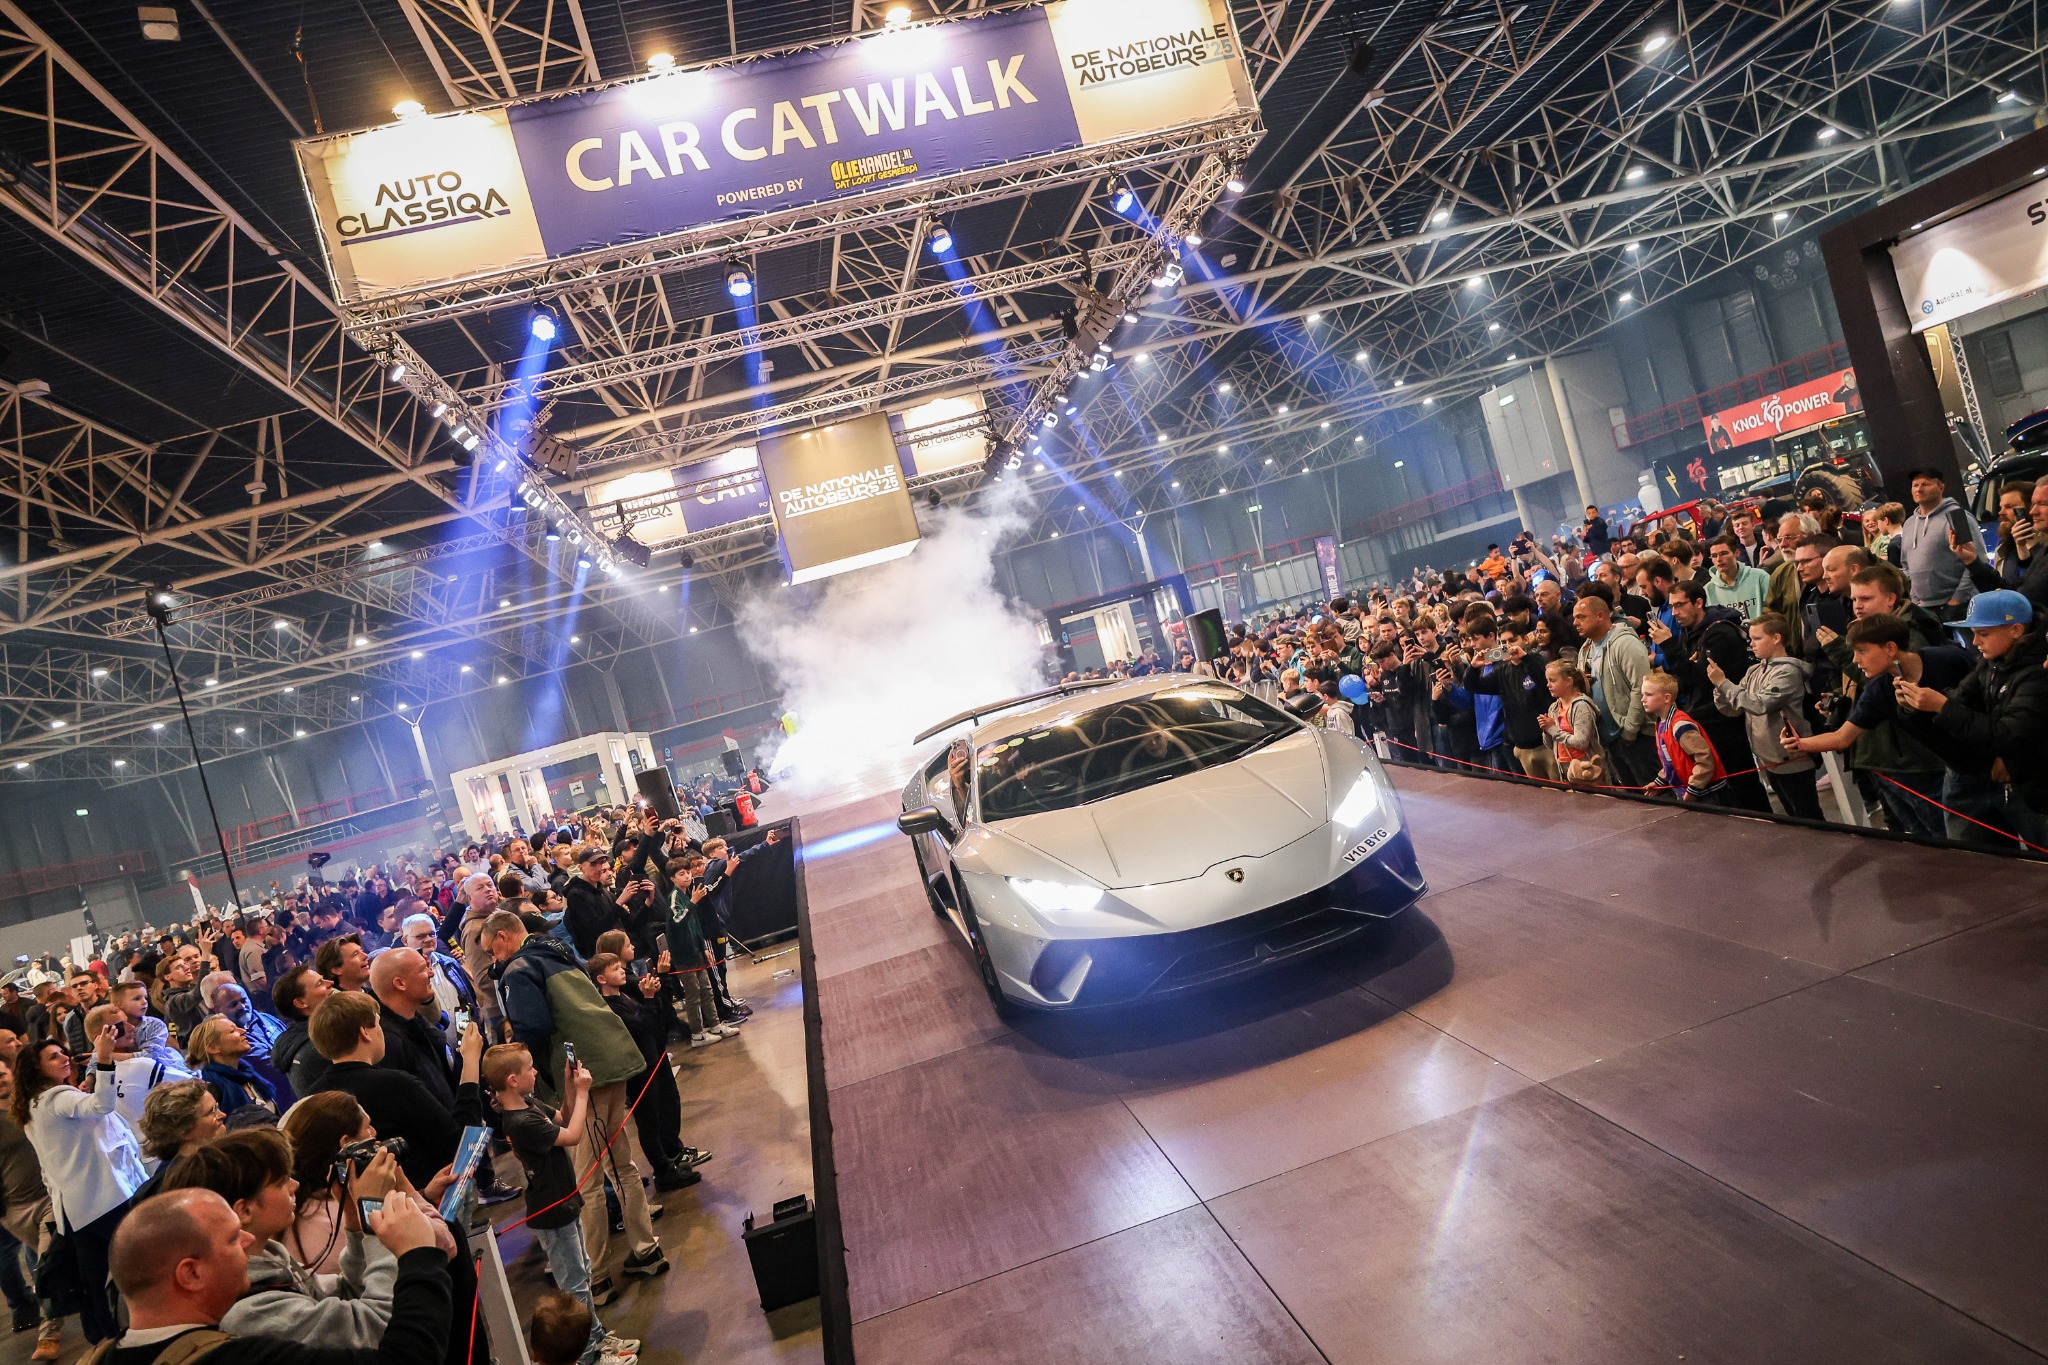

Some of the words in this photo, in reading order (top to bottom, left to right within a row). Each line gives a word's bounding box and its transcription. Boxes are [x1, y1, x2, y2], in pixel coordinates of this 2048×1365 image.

[1071, 50, 1103, 69] DE
[1107, 23, 1229, 62] NATIONALE
[564, 121, 711, 192] CAR
[720, 54, 1039, 162] CATWALK
[375, 170, 462, 206] AUTO
[716, 182, 785, 206] POWERED
[786, 177, 804, 192] BY
[835, 179, 852, 190] DAT
[851, 173, 877, 187] LOOPT
[877, 163, 919, 180] GESMEERD!
[335, 187, 509, 237] CLASSIQA
[2027, 198, 2048, 226] S
[1731, 413, 1765, 434] KNOL
[1784, 391, 1831, 418] POWER
[779, 487, 804, 503] DE
[805, 464, 896, 497] NATIONALE
[1343, 845, 1367, 862] V10
[1364, 829, 1388, 848] BYG
